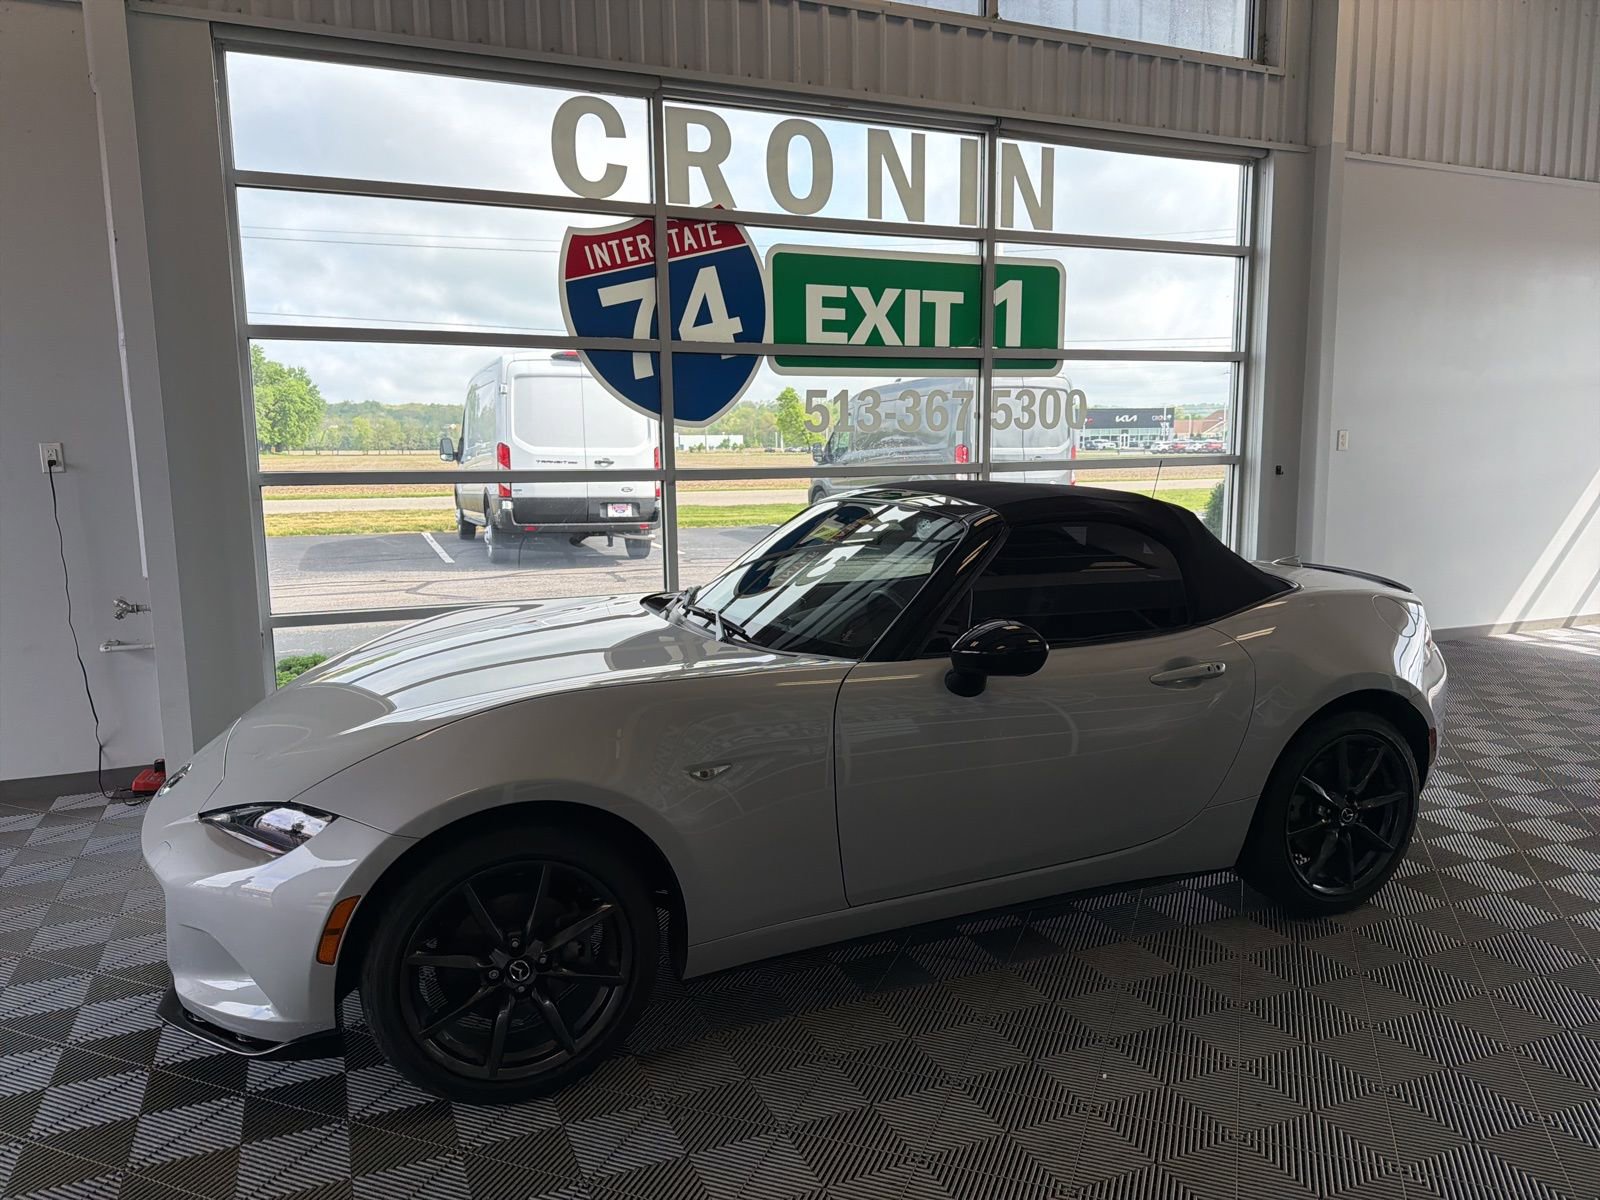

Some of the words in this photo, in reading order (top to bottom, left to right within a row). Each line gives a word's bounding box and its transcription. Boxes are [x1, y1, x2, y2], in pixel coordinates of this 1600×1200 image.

[550, 95, 1055, 231] CRONIN
[584, 222, 722, 270] INTERTATE
[597, 265, 743, 380] 74
[805, 283, 964, 347] EXIT
[993, 279, 1023, 347] 1
